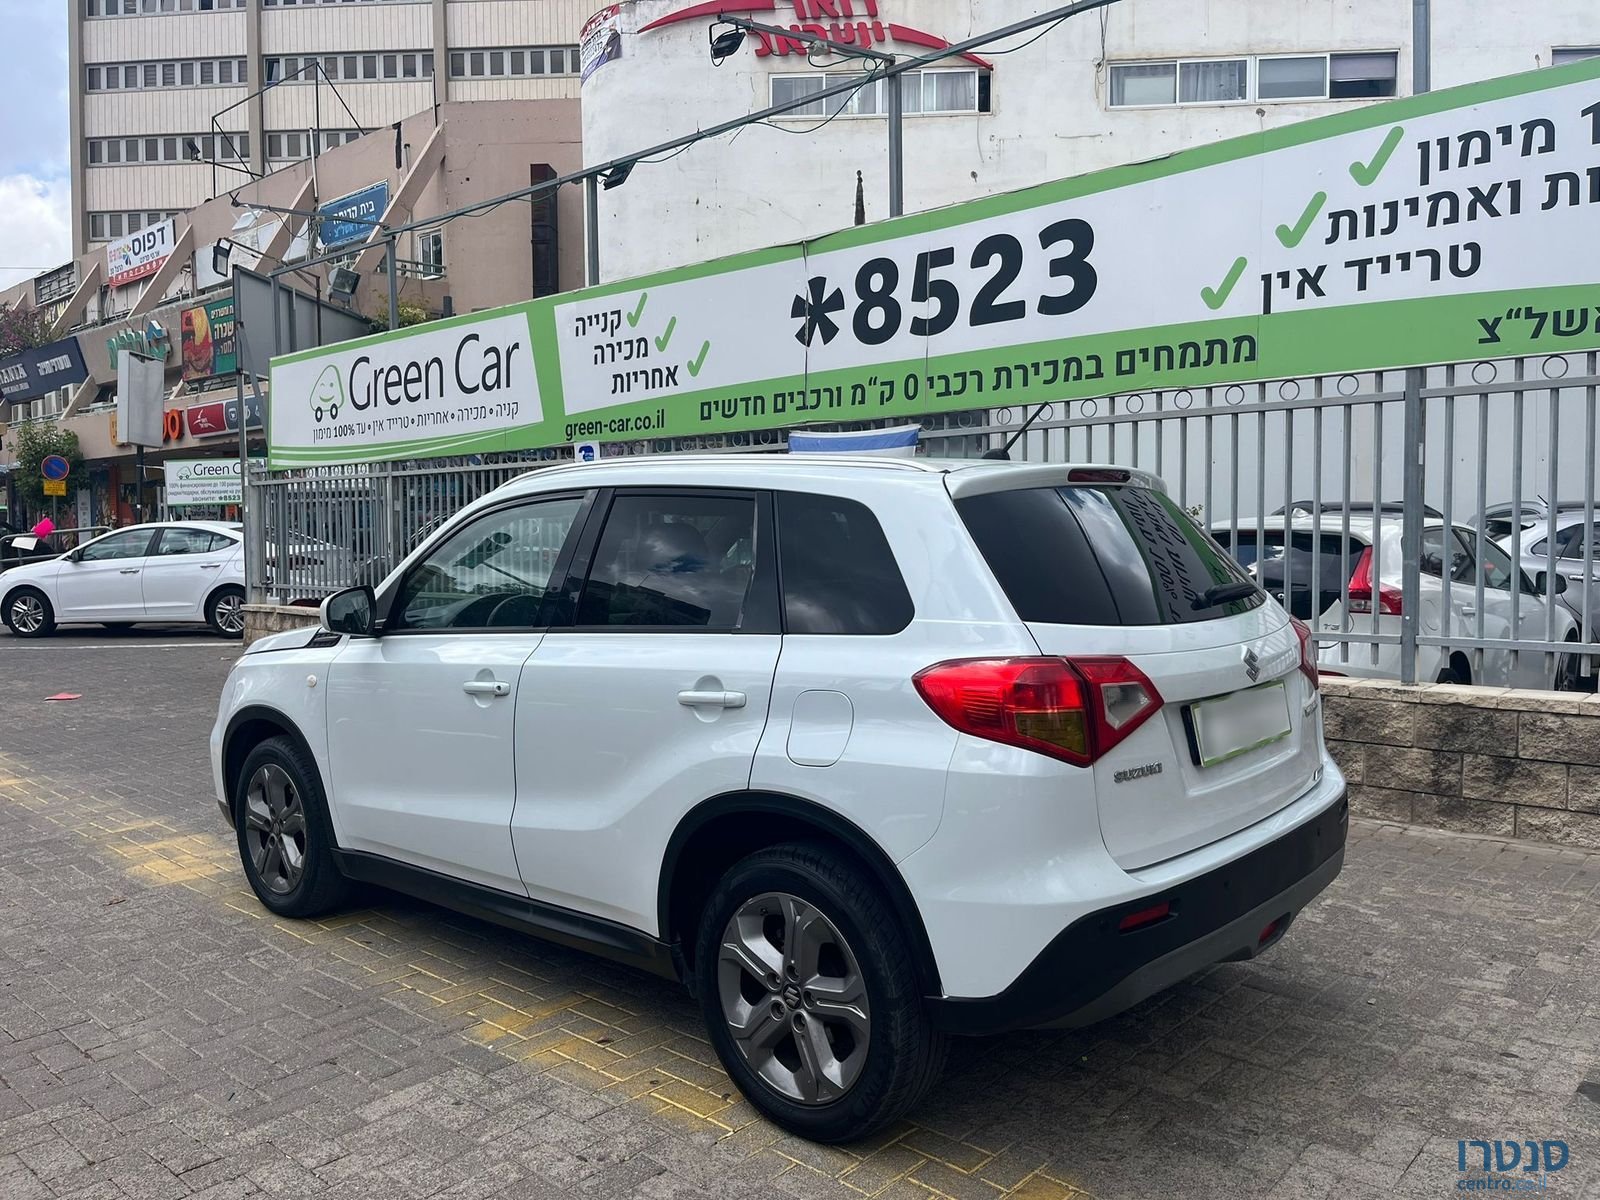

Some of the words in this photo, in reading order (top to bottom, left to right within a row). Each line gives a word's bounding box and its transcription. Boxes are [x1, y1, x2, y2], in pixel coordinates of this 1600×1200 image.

[1417, 118, 1555, 186] מימון
[360, 201, 375, 215] בית
[1325, 179, 1521, 245] ואמינות
[132, 226, 165, 256] דפוס
[1345, 241, 1481, 291] טרייד
[1260, 264, 1327, 315] אין
[575, 309, 622, 337] קנייה
[594, 337, 649, 365] מכירה
[1115, 334, 1257, 376] מתמחים
[350, 356, 444, 411] Green
[455, 333, 520, 394] Car
[611, 365, 679, 394] אחריות
[927, 369, 983, 398] רכבי
[992, 353, 1105, 392] במכירת
[773, 386, 843, 414] ורכבים
[903, 373, 919, 400] 0
[417, 410, 449, 428] אחריות
[457, 405, 487, 422] מכירה
[496, 401, 519, 420] קניה
[700, 394, 766, 421] חדשים
[313, 427, 332, 444] מימון
[334, 423, 355, 438] 100%
[356, 422, 366, 435] עד
[373, 418, 385, 437] אין
[387, 415, 410, 431] טרייד
[565, 408, 665, 442] green-car.co.il
[193, 463, 230, 476] Green
[1113, 762, 1163, 784] SUZUKI
